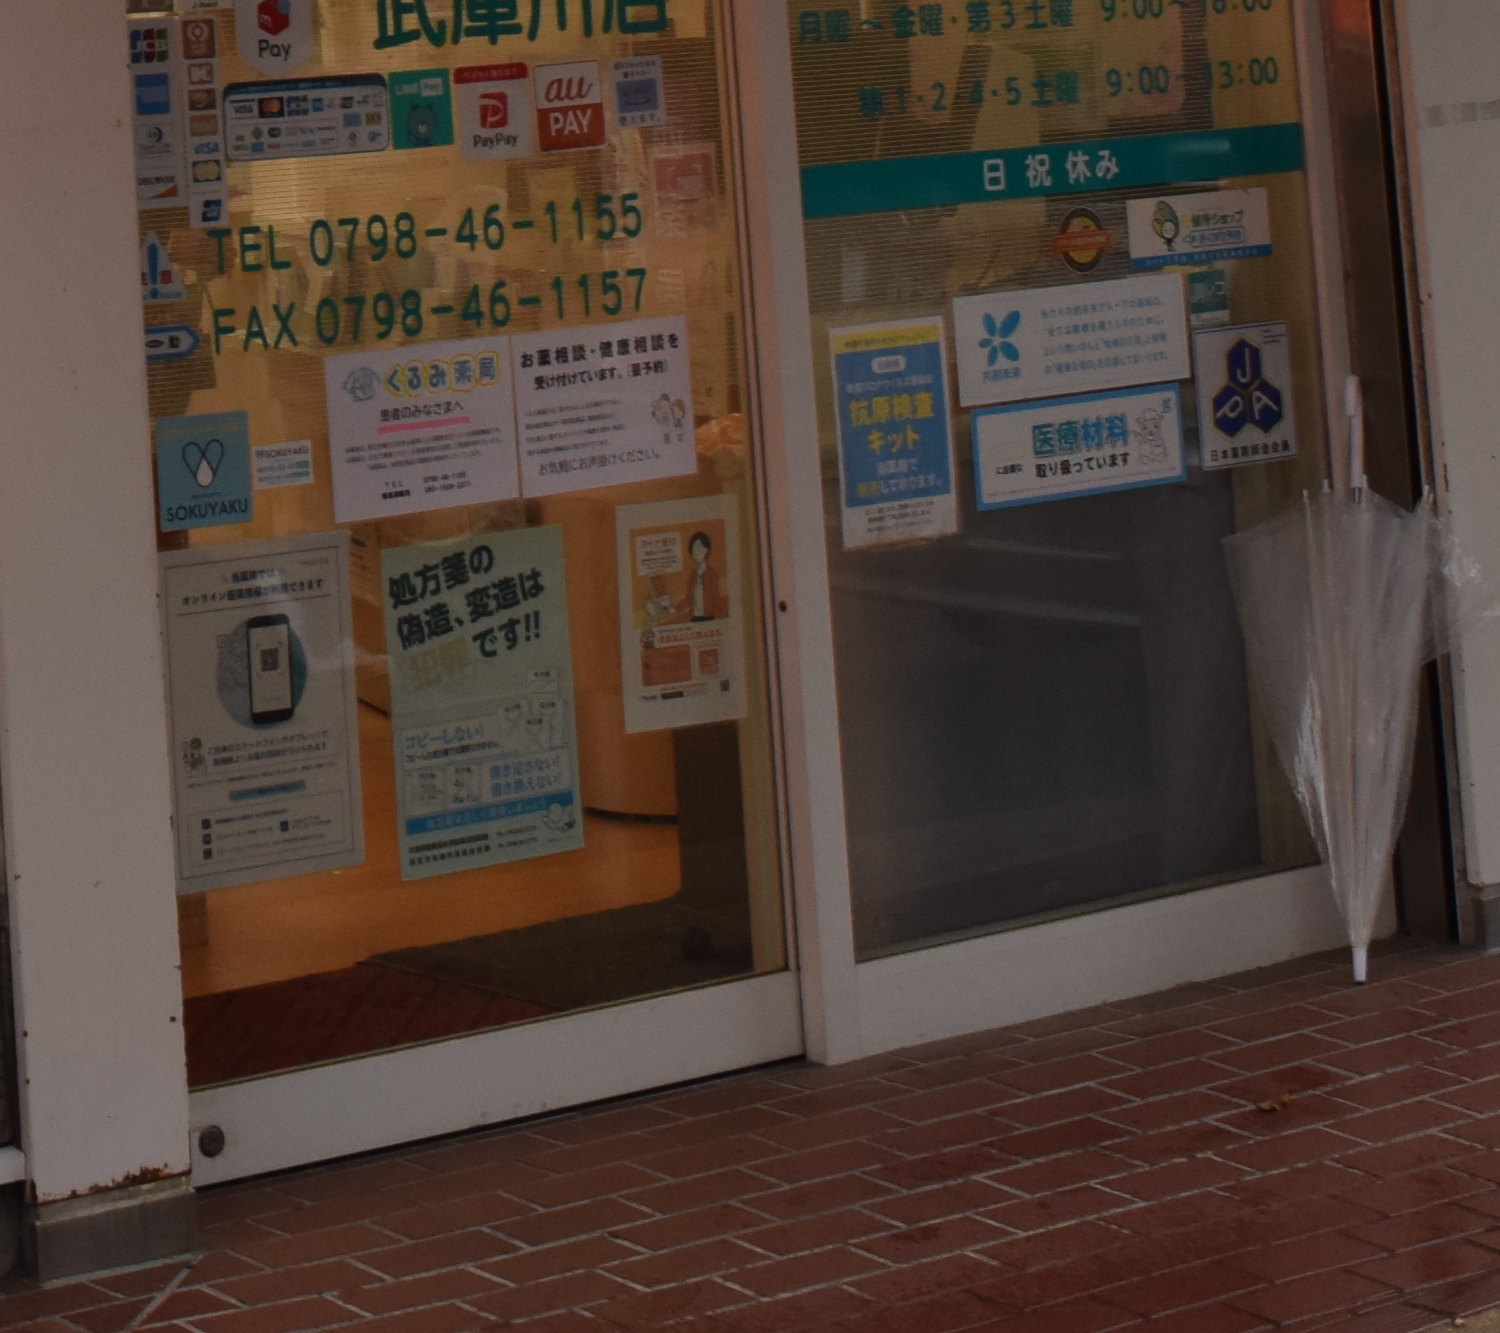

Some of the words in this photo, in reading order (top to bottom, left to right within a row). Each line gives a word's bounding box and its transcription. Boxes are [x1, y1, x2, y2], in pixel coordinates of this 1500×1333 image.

[258, 39, 292, 61] Pay
[544, 75, 593, 102] au
[550, 108, 592, 137] PAY
[194, 141, 219, 155] VISA
[473, 132, 518, 149] PayPay
[982, 148, 1121, 193] 日祝休み
[207, 224, 292, 274] TEL
[309, 191, 643, 267] 0798-46-1155
[213, 302, 299, 355] FAX
[315, 268, 648, 346] 0798-46-1157
[521, 333, 679, 368] お薬相談・健康相談を
[385, 353, 498, 395] くるみ薬局
[380, 400, 464, 423] 患者のみなさまへ
[849, 391, 935, 428] 抗原検査
[867, 424, 920, 455] キット
[1032, 412, 1128, 459] 医療材料
[1210, 439, 1290, 463] 日本薬剤師会会員
[1034, 451, 1130, 479] 取り扱っています
[166, 497, 248, 523] SOKUYAKU
[389, 544, 494, 610] 処方箋の
[397, 567, 545, 651] 偽造、変造は
